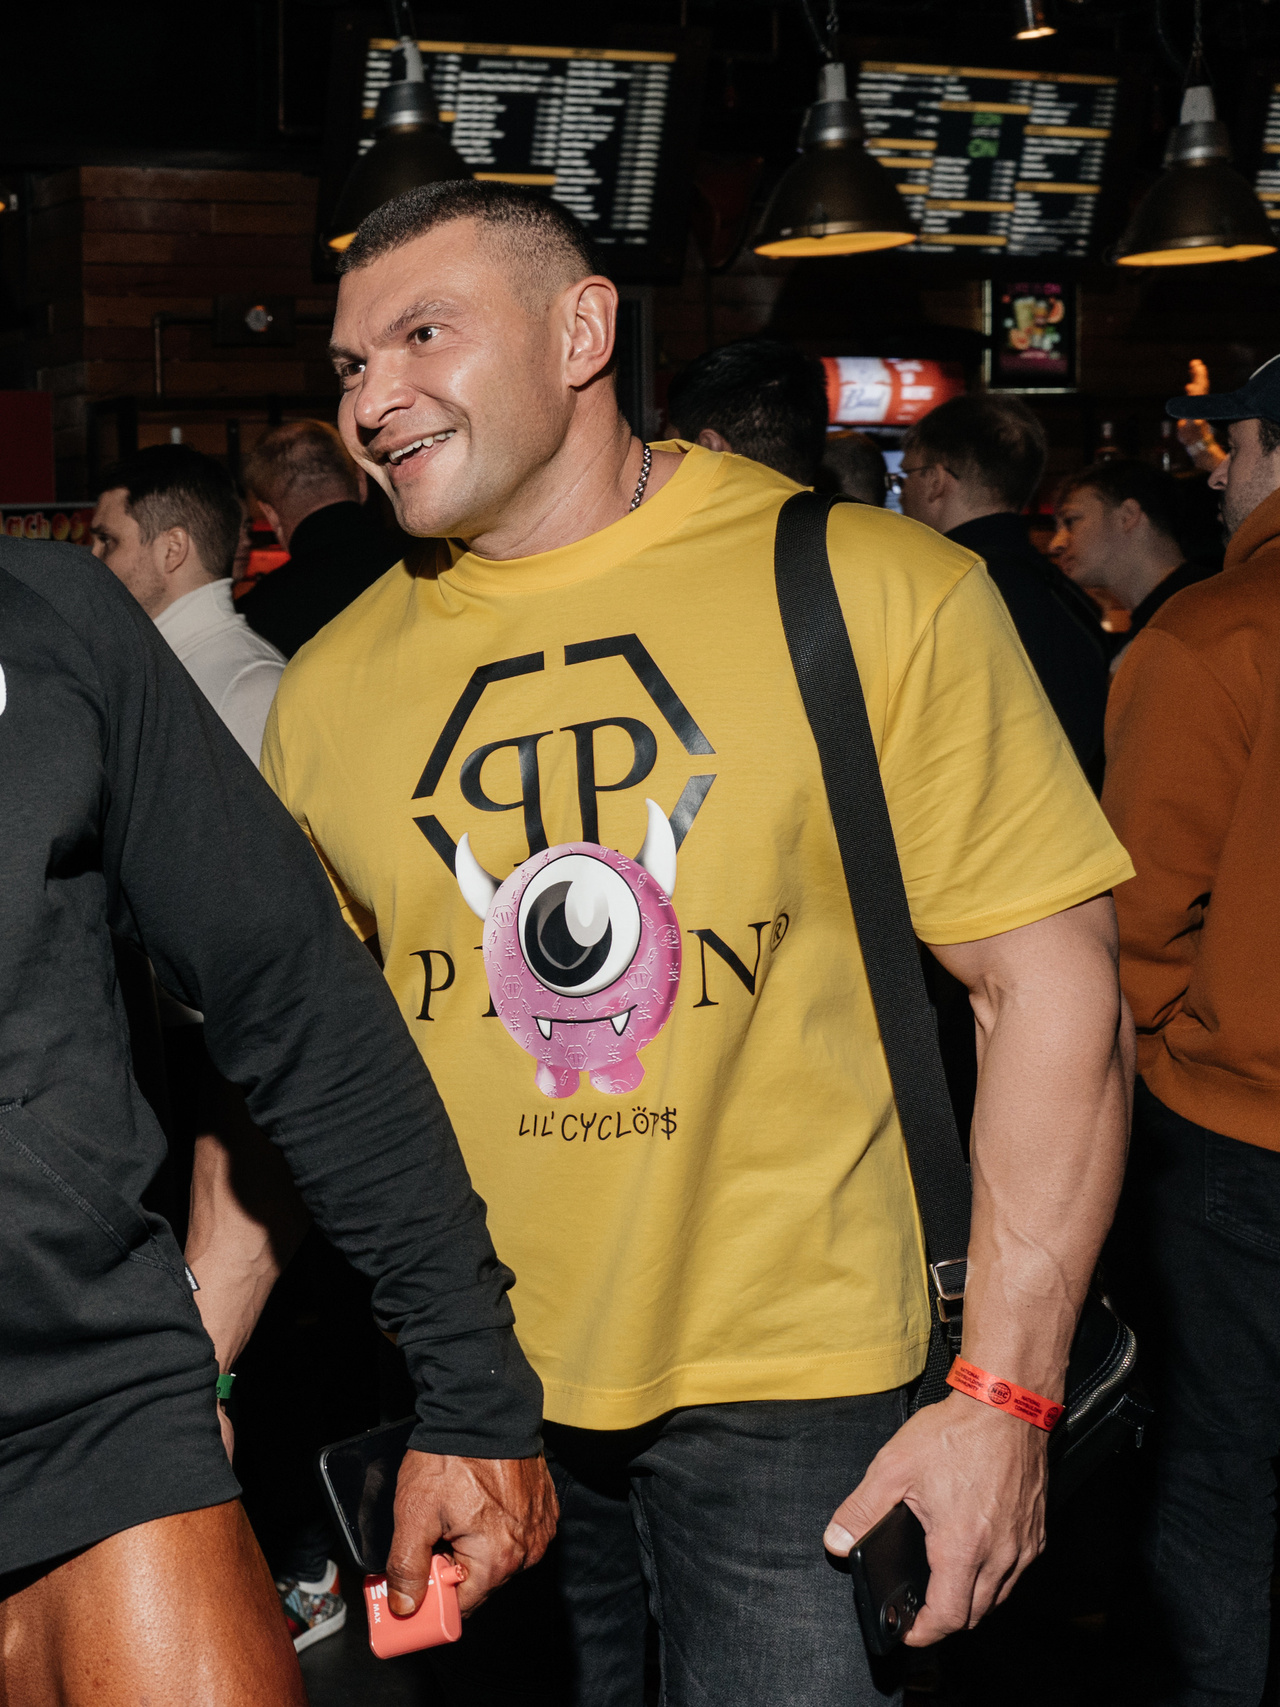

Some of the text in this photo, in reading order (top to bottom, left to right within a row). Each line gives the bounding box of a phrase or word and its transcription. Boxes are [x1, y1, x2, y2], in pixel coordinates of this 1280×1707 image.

[518, 1111, 555, 1137] LIL'
[991, 1386, 1010, 1400] NBC
[373, 1603, 381, 1624] MAX
